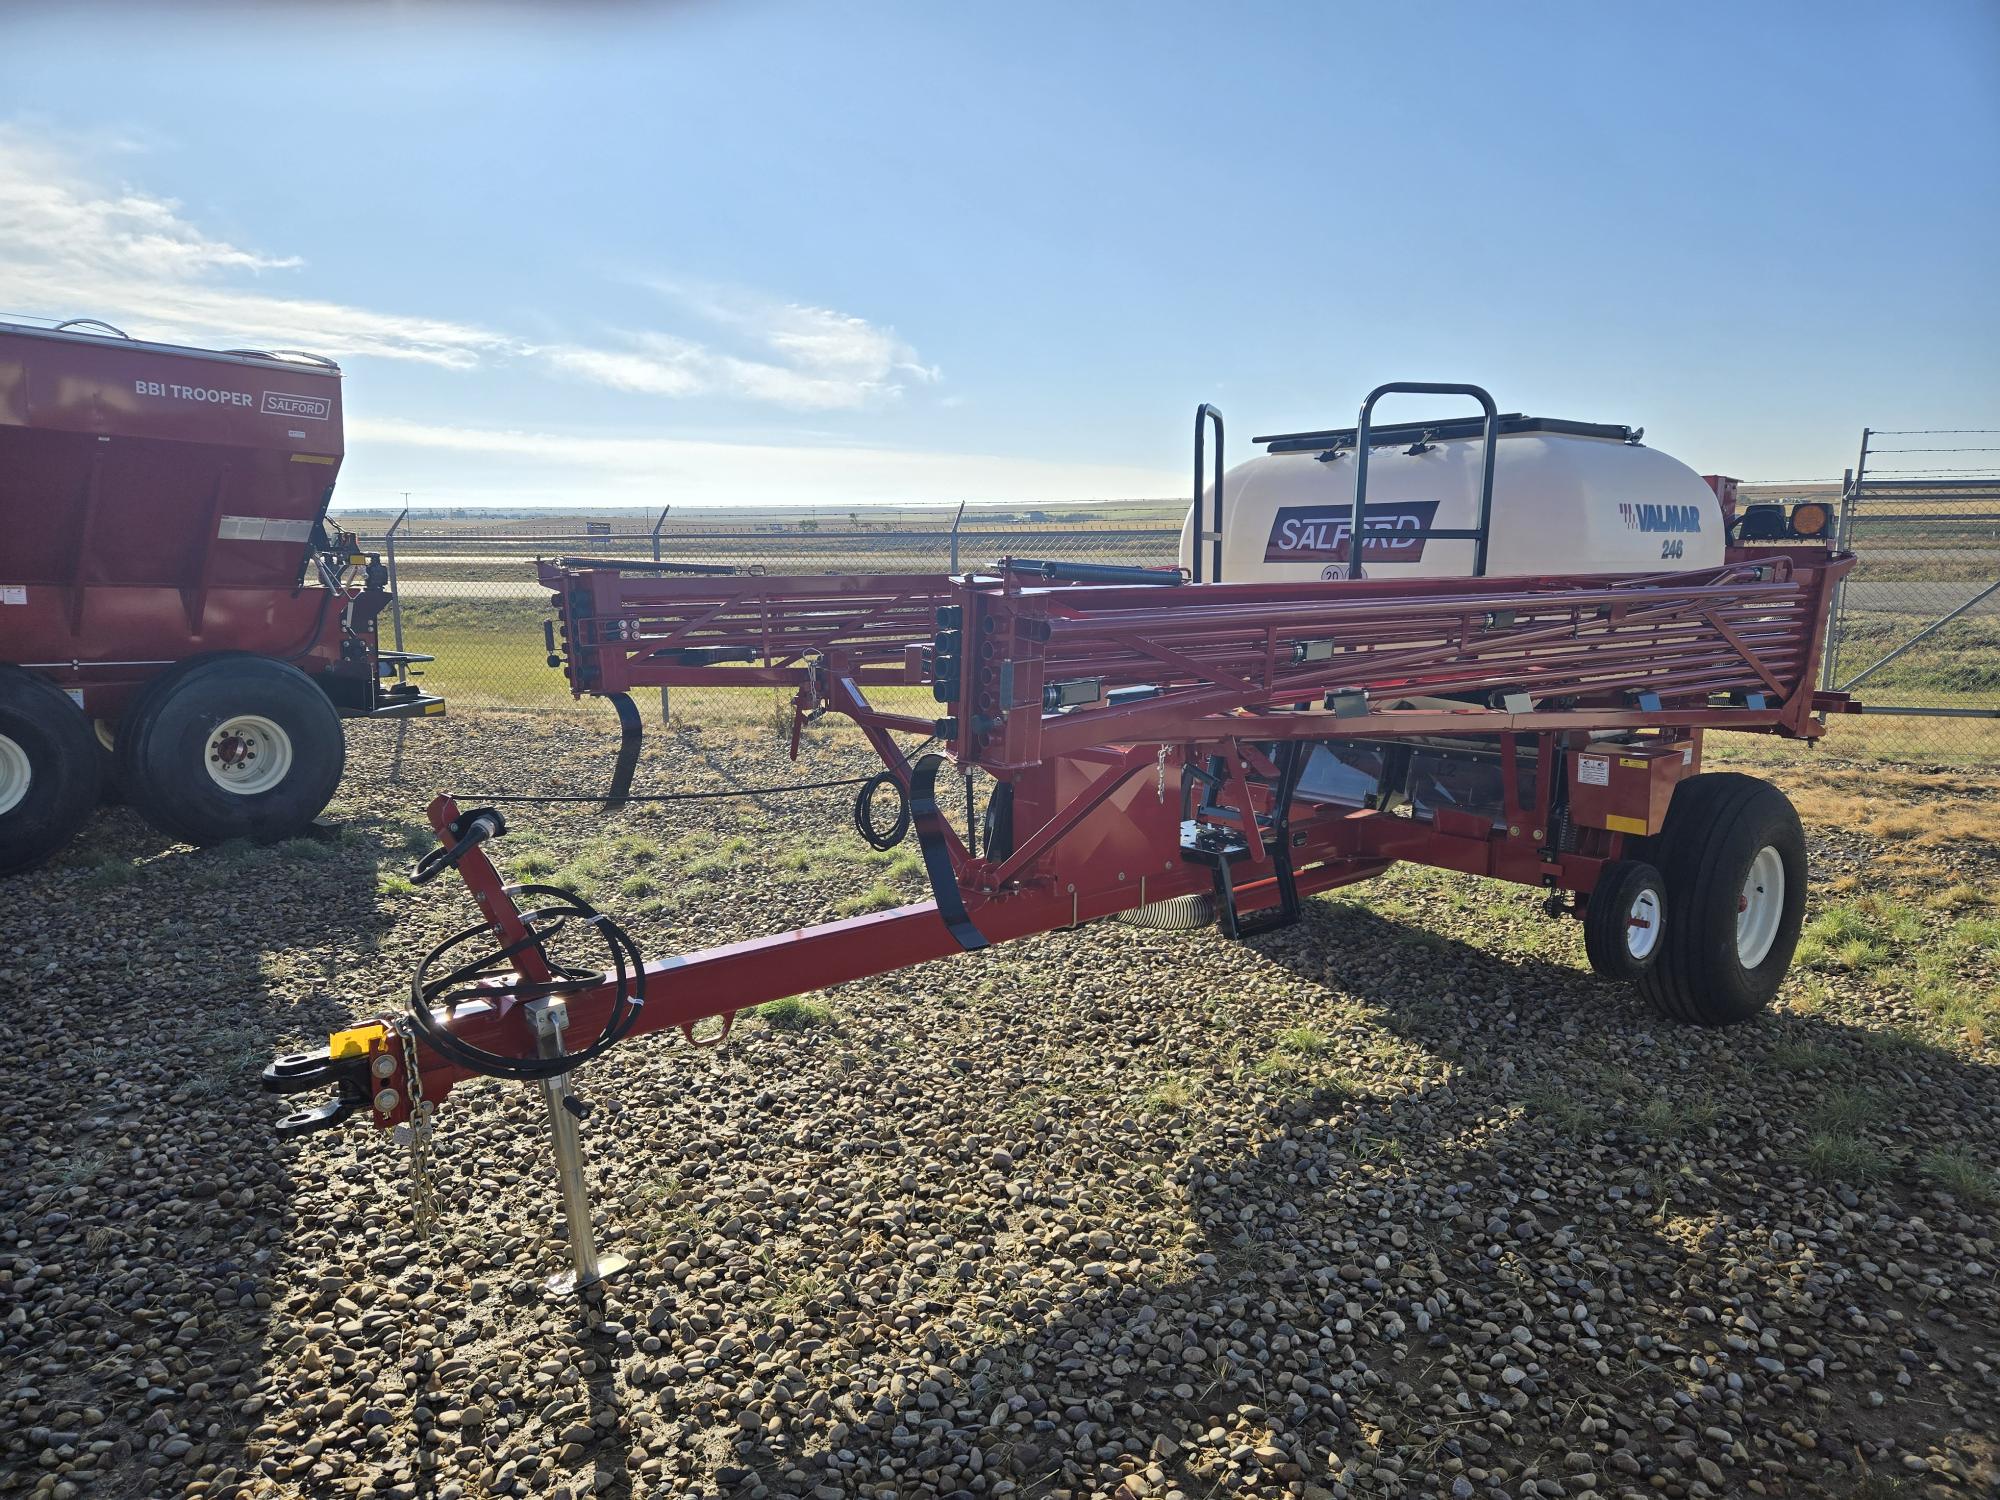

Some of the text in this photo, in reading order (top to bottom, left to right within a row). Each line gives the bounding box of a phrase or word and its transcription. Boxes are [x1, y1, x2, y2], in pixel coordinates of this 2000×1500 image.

[135, 380, 253, 407] BBI TROOPER
[267, 396, 325, 415] SALFORD
[1635, 503, 1701, 532] VALMAR
